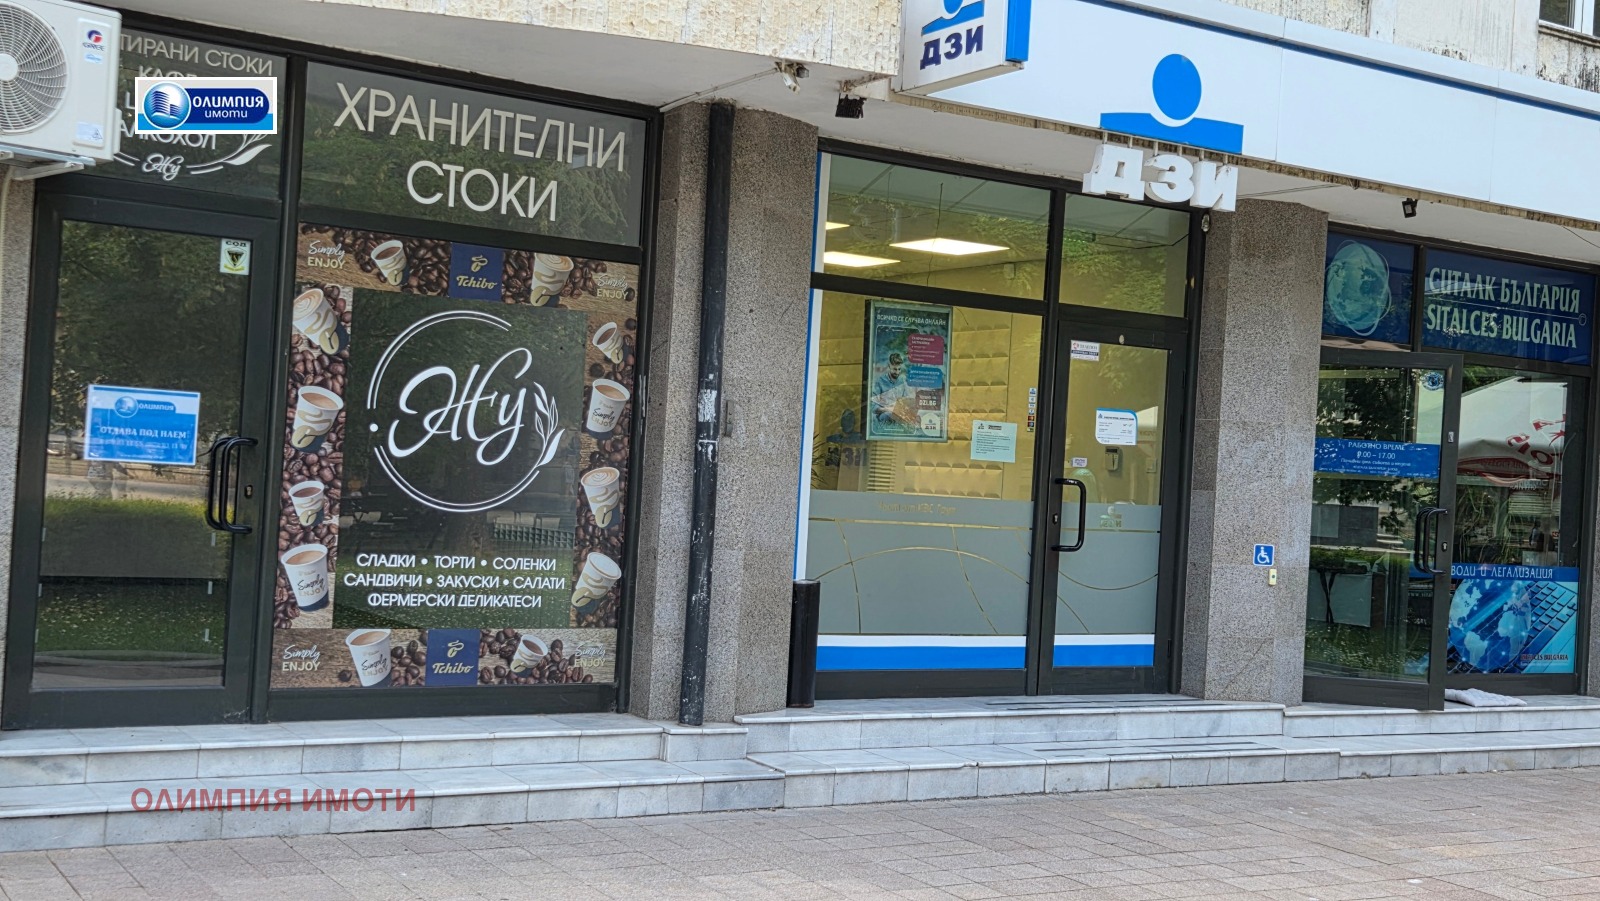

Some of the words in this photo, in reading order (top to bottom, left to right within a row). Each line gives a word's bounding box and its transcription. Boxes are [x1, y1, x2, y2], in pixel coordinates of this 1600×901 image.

[920, 25, 983, 70] ДЗИ
[205, 50, 273, 76] СТОКИ
[333, 82, 626, 172] ХРАНИТЕЛНИ
[1082, 143, 1238, 213] ДЗИ
[406, 160, 558, 222] СТОКИ
[308, 240, 345, 260] Simply
[307, 257, 345, 268] ENJOY
[456, 275, 498, 290] Tchibo
[597, 274, 629, 291] Simply
[1429, 267, 1496, 302] СИТАЛК
[1501, 278, 1580, 314] БЪЛГАРИЯ
[596, 288, 629, 300] ENJOY
[1426, 303, 1497, 338] SITALCES
[1502, 314, 1577, 348] BULGARIA
[100, 426, 138, 436] ОТДАВА
[140, 429, 159, 438] ПОД
[160, 430, 187, 439] НАЕМ
[356, 553, 416, 568] СЛАДКИ
[434, 555, 476, 569] ТОРТИ
[492, 557, 556, 571] СОЛЕНКИ
[1480, 567, 1486, 577] И
[1491, 566, 1553, 579] ЛЕГАЛИЗАЦИЯ
[344, 573, 422, 587] САНДВИЧИ
[436, 575, 499, 588] ЗАКУСКИ
[513, 577, 565, 590] САЛАТИ
[368, 593, 457, 607] ФЕРМЕРСКИ
[457, 595, 542, 608] ДЕЛИКАТЕСИ
[283, 644, 321, 663] Simply
[575, 643, 606, 659] Simply
[282, 661, 320, 672] ENJOY
[432, 663, 474, 675] Tchibo
[574, 658, 605, 668] ENJOY
